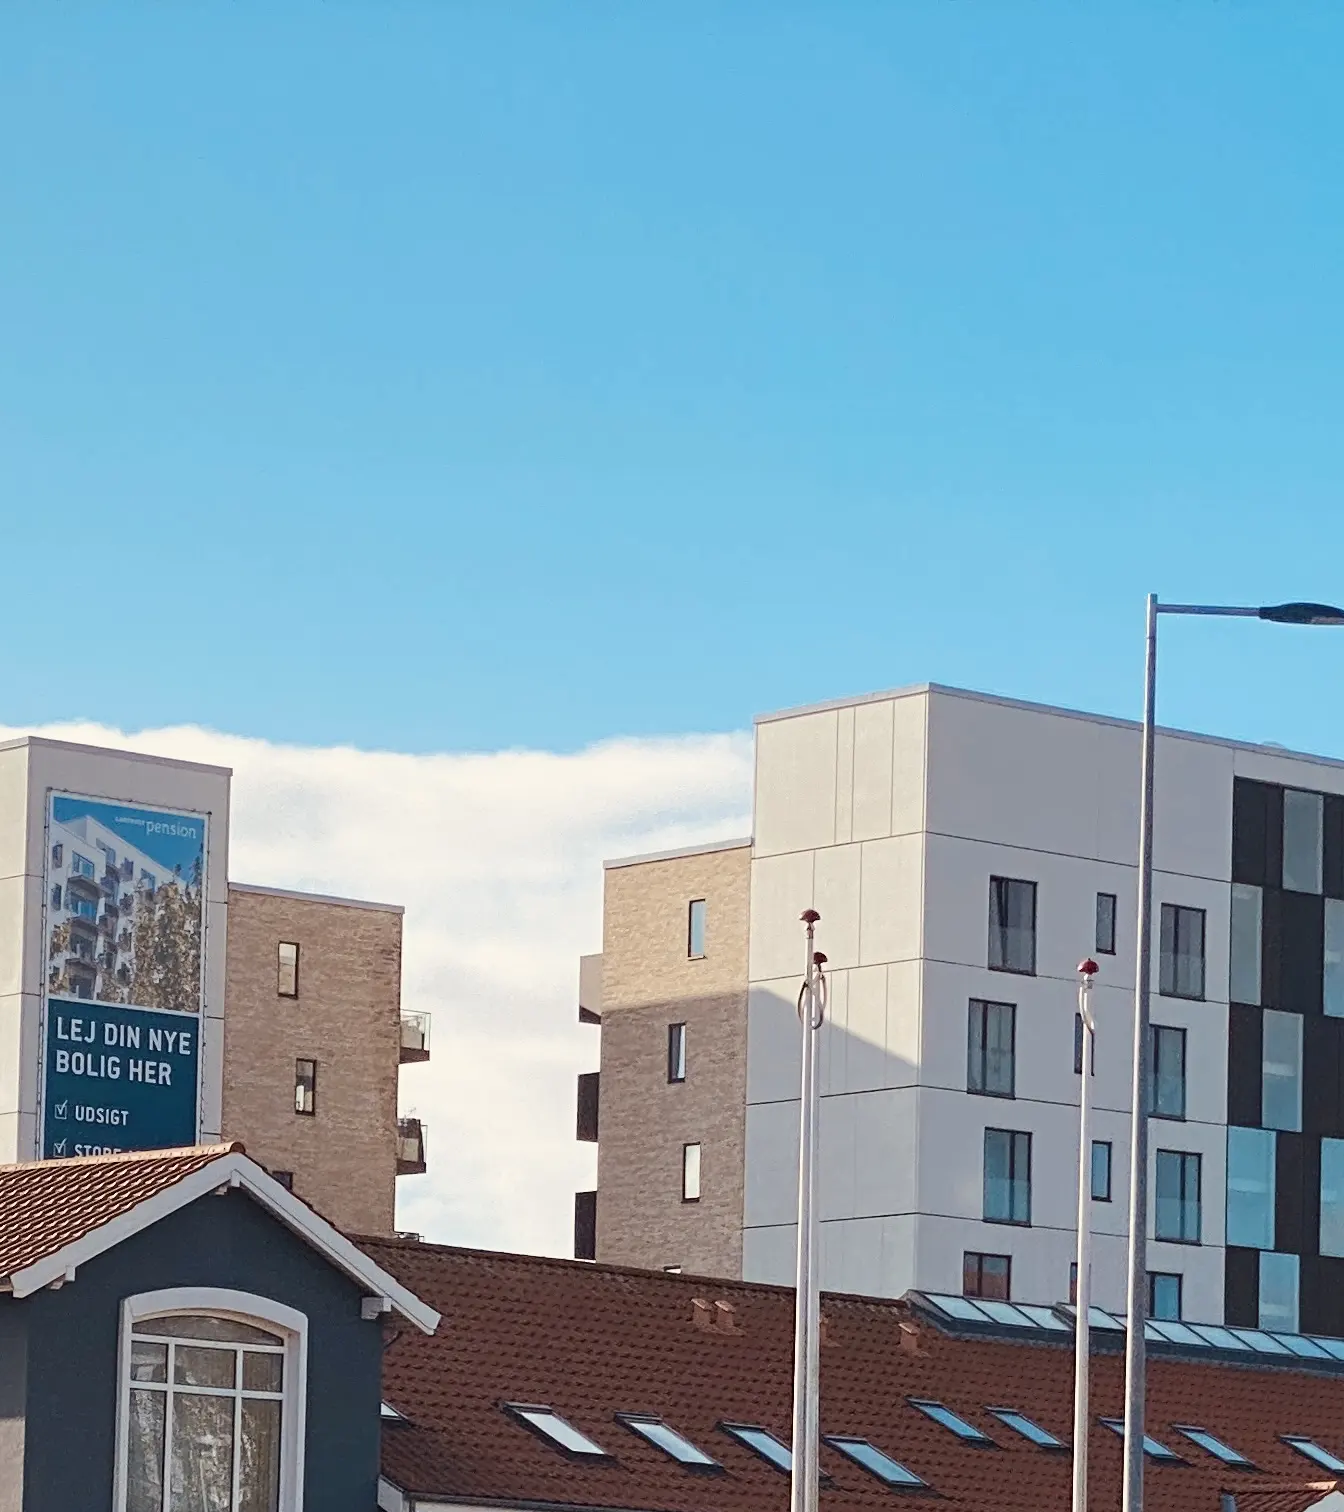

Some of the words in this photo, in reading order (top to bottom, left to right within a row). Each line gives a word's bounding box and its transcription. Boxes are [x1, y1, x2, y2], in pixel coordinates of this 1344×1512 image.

[146, 821, 197, 839] pension
[57, 1016, 96, 1043] LEJ
[104, 1022, 140, 1049] DIN
[149, 1028, 191, 1055] NYE
[56, 1049, 120, 1079] BOLIG
[129, 1059, 172, 1085] HER
[75, 1105, 129, 1126] UDSIGT
